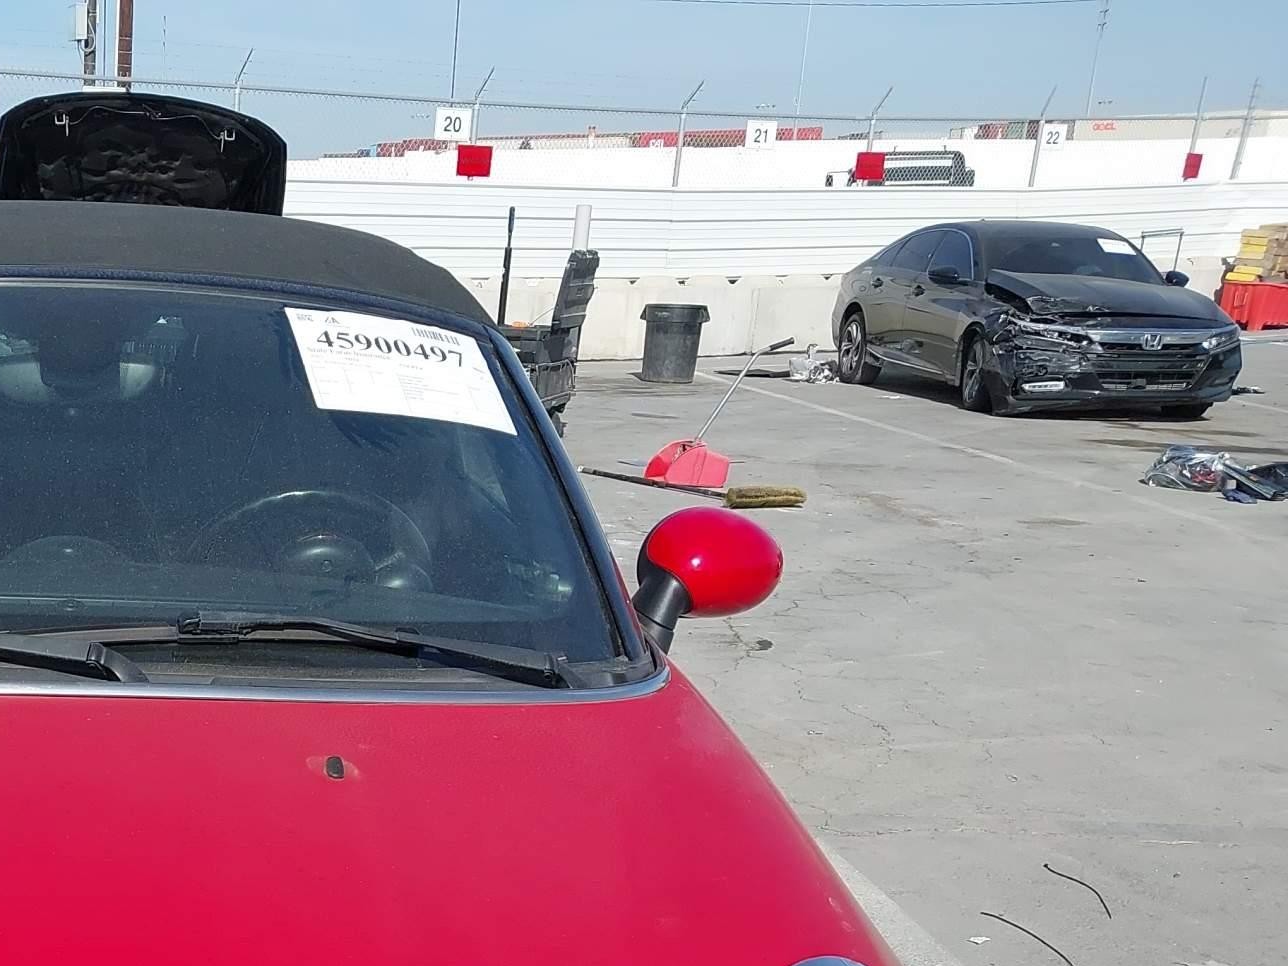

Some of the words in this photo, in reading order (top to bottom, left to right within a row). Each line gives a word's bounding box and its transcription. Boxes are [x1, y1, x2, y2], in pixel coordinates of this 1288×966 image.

[443, 115, 462, 133] 20
[753, 128, 769, 144] 21
[1045, 130, 1060, 145] 22
[316, 329, 464, 368] 45900497
